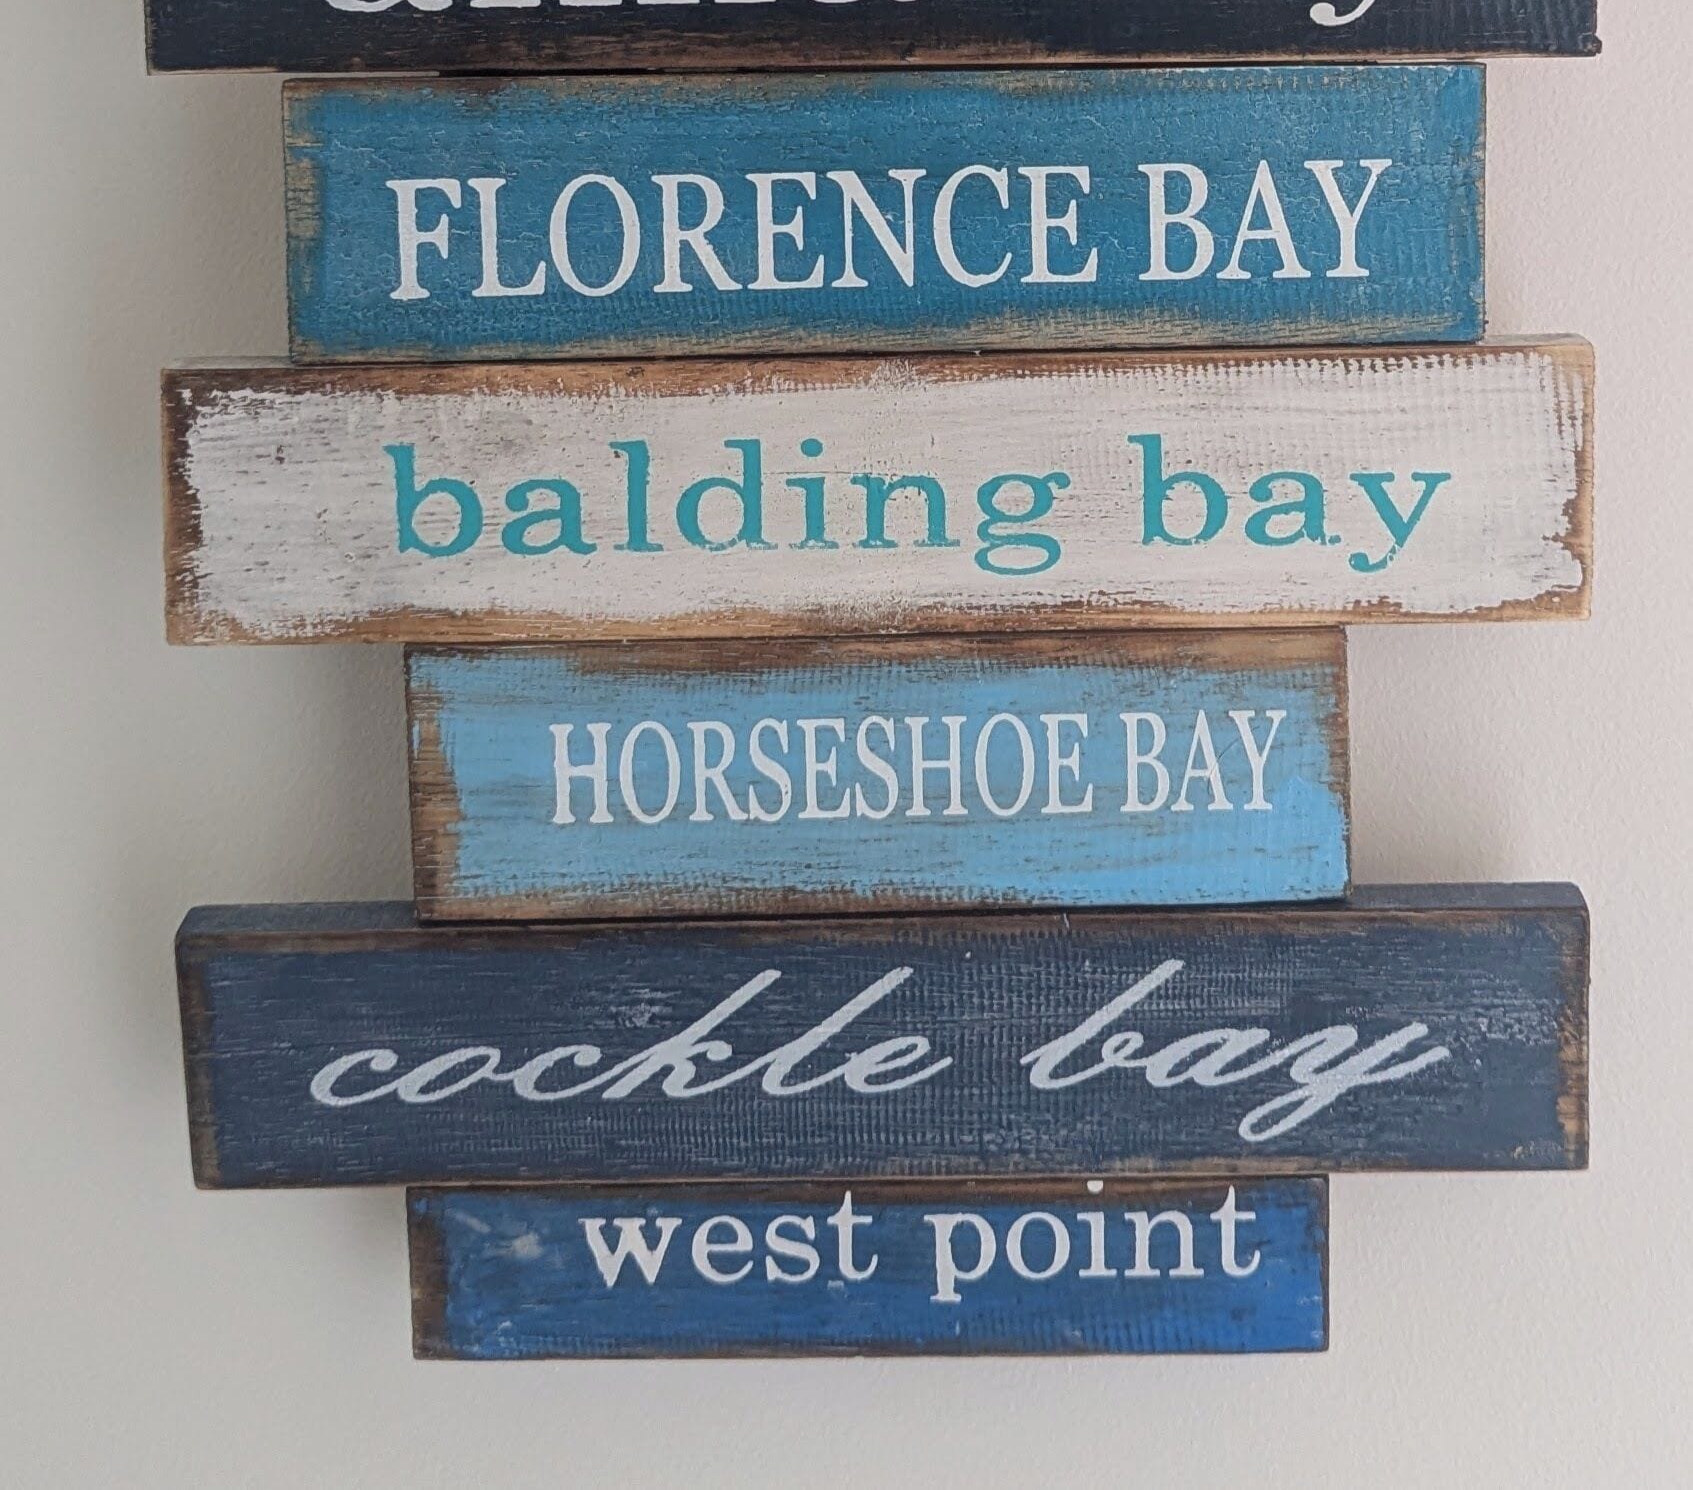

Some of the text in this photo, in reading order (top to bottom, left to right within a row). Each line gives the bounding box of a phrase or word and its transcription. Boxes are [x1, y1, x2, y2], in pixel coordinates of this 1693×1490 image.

[386, 159, 1392, 301] FLORENCE BAY
[387, 435, 1449, 573] balding bay
[549, 710, 1286, 824] HORSESHOE BAY
[311, 959, 1453, 1143] cockle bay
[578, 1181, 1260, 1302] west point
